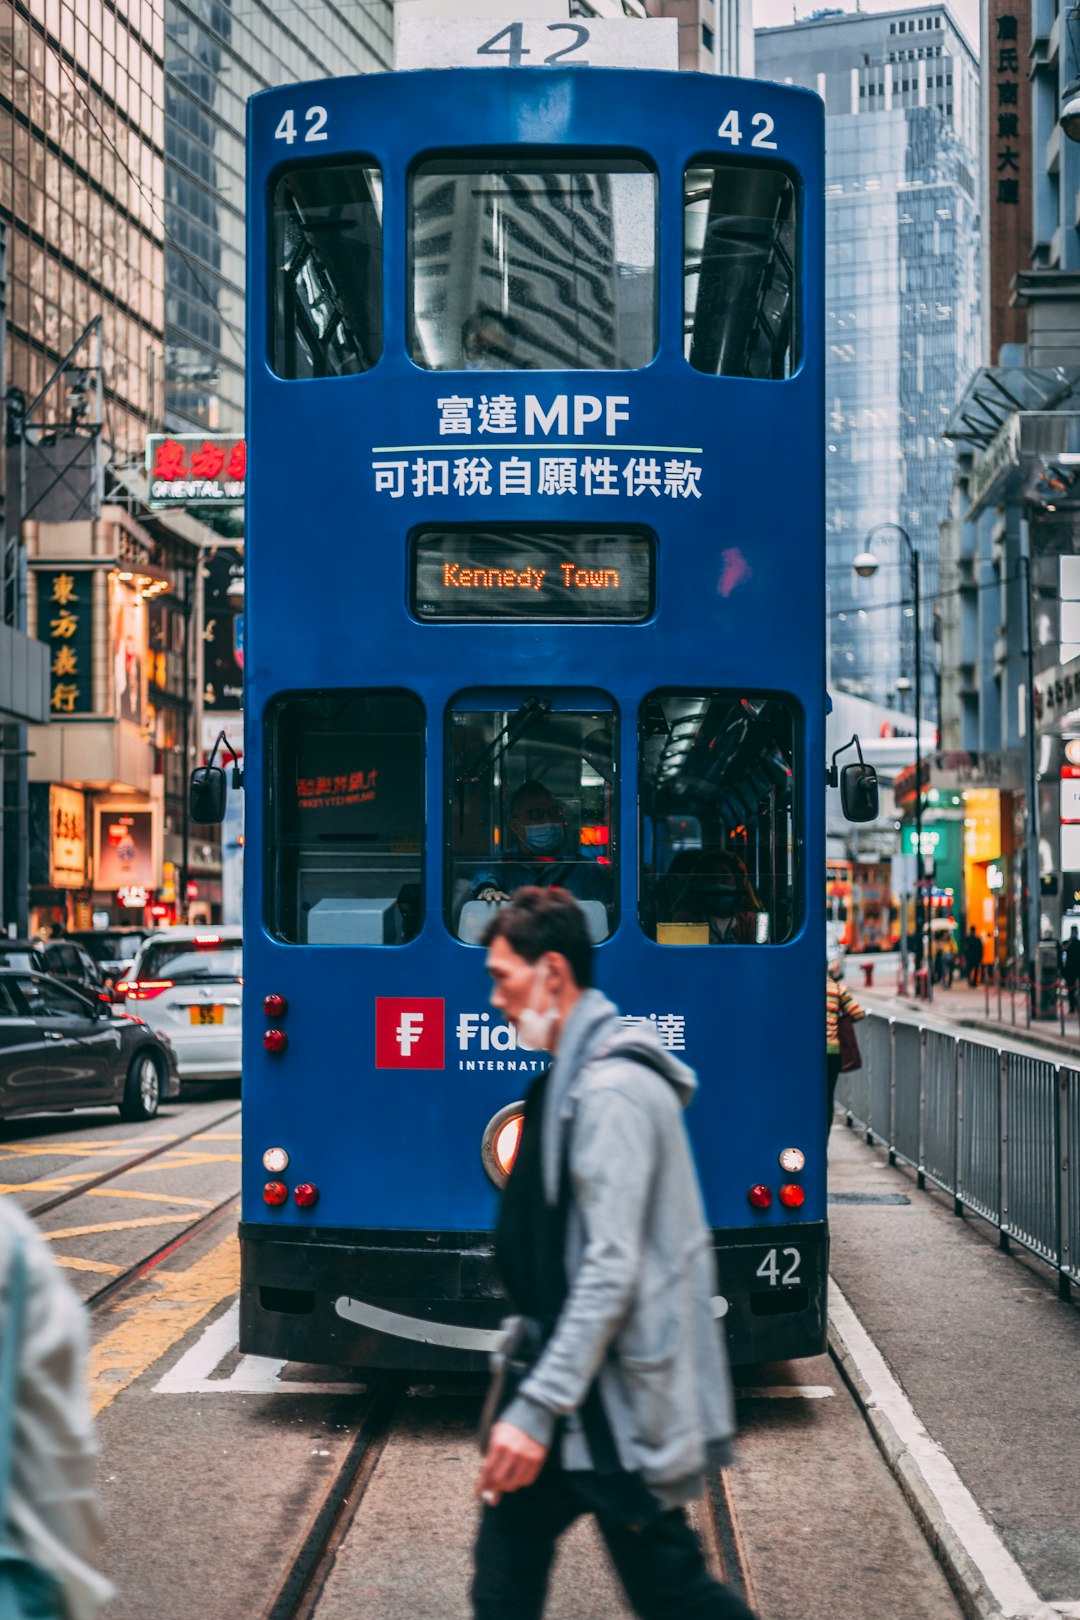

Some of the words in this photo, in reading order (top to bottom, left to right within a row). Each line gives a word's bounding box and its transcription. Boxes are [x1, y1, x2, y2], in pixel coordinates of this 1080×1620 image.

[477, 22, 590, 66] 42
[275, 106, 328, 144] 42
[718, 110, 778, 150] 42
[152, 481, 224, 498] ORIENTAL
[372, 456, 703, 499] 可扣稅自願性供款
[442, 562, 545, 590] Kennedy
[561, 562, 619, 588] Town
[50, 572, 79, 712] 東方表行
[756, 1247, 801, 1285] 42
